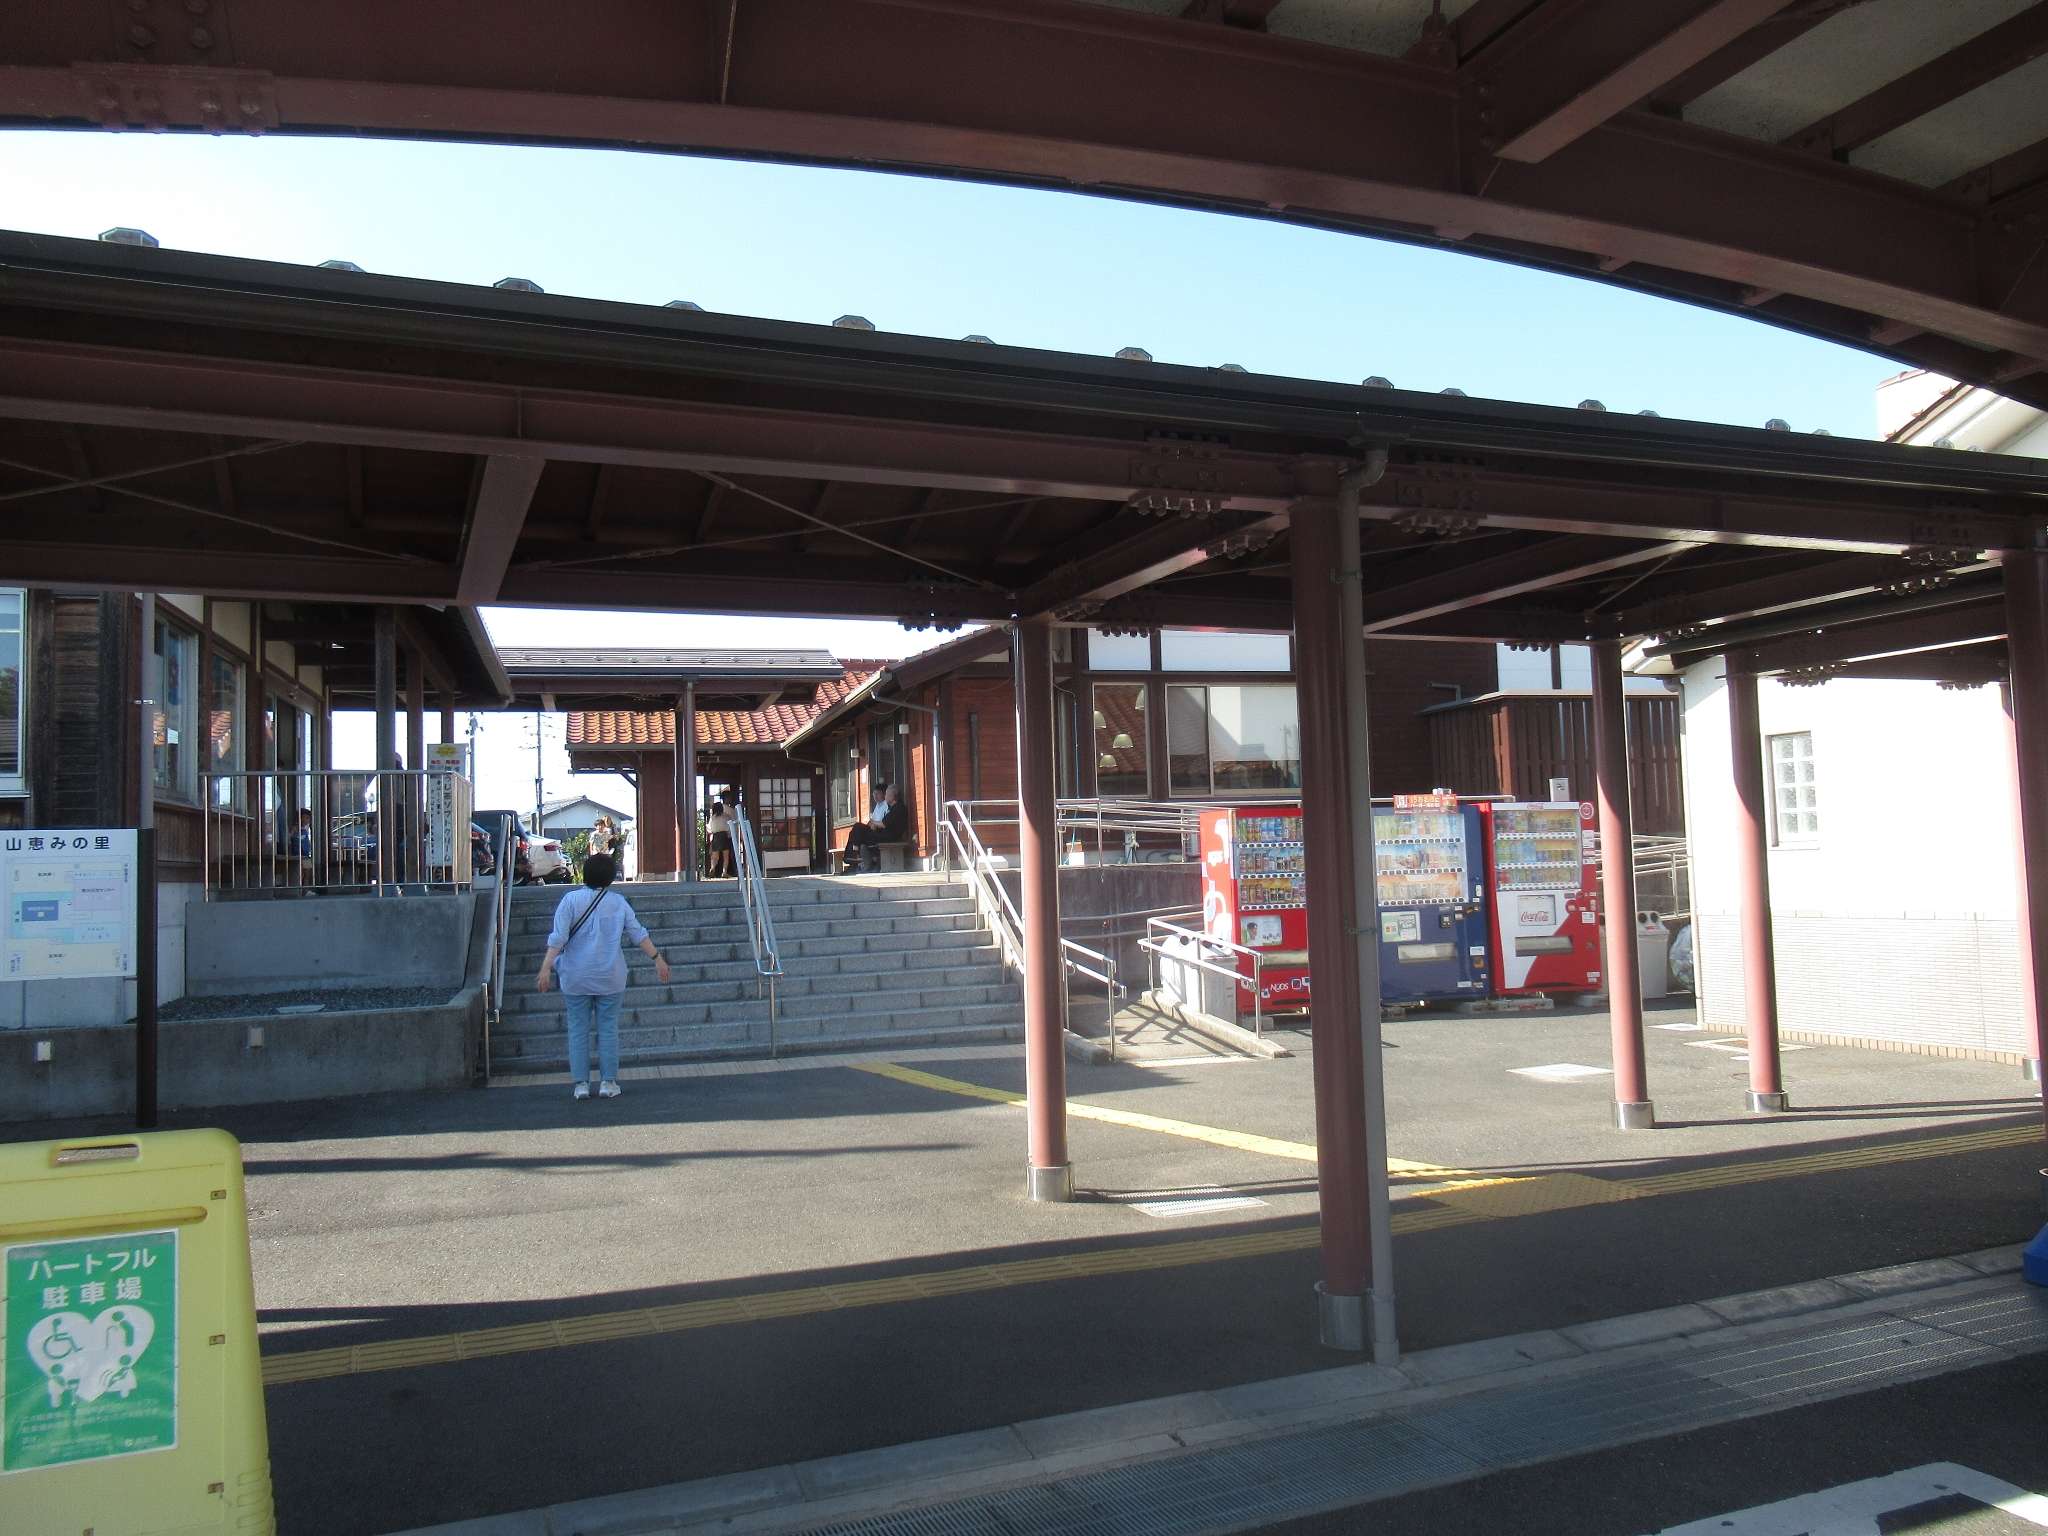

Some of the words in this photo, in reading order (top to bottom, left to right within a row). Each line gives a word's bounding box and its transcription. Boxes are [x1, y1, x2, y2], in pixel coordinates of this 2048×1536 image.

[5, 836, 111, 851] 山恵みの里
[28, 1247, 157, 1281] ハートフル
[42, 1275, 143, 1310] 駐車場
